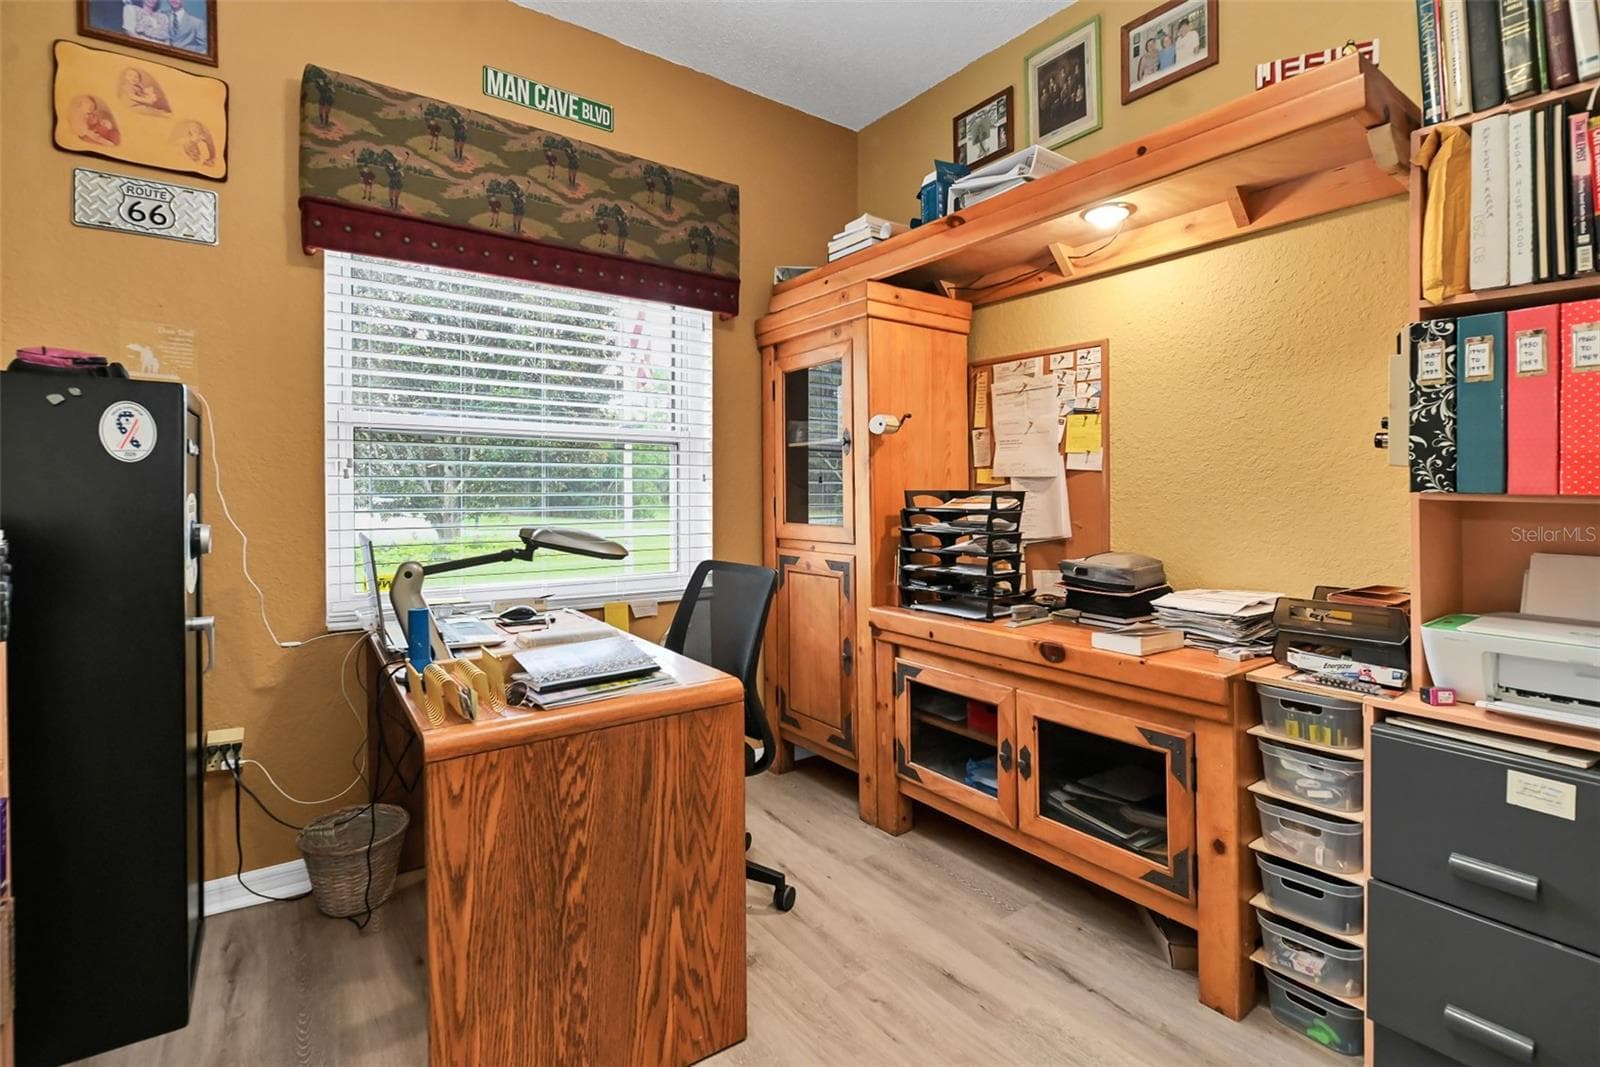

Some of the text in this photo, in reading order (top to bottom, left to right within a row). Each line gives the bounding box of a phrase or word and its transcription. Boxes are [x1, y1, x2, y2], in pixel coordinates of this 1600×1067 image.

[487, 68, 611, 126] MAN CAVE BLVD
[126, 185, 167, 200] ROUTE
[128, 201, 167, 226] 66
[1323, 662, 1353, 671] Energizer
